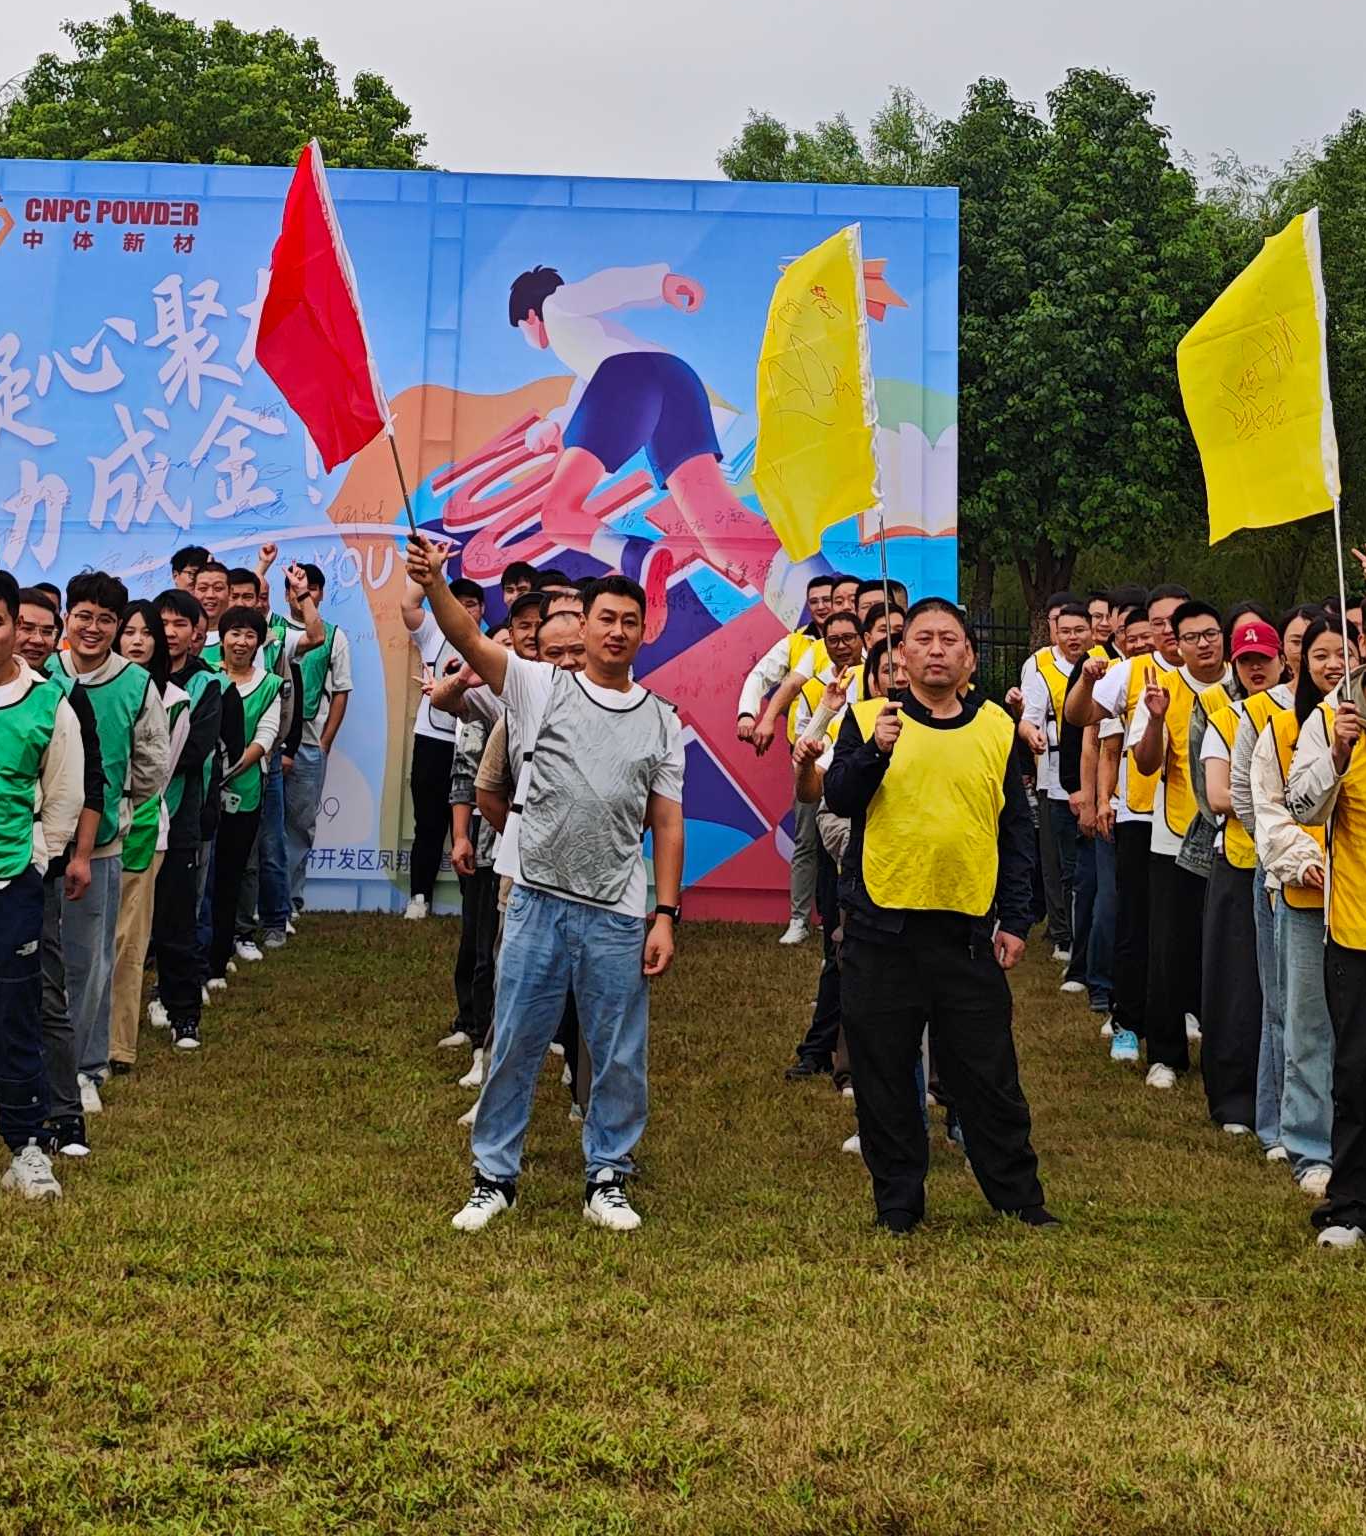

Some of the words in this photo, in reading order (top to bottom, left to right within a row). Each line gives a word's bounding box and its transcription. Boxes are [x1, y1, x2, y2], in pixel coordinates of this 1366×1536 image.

[25, 197, 91, 224] CNPC
[96, 199, 199, 227] POWDER
[22, 228, 196, 254] 中体新材
